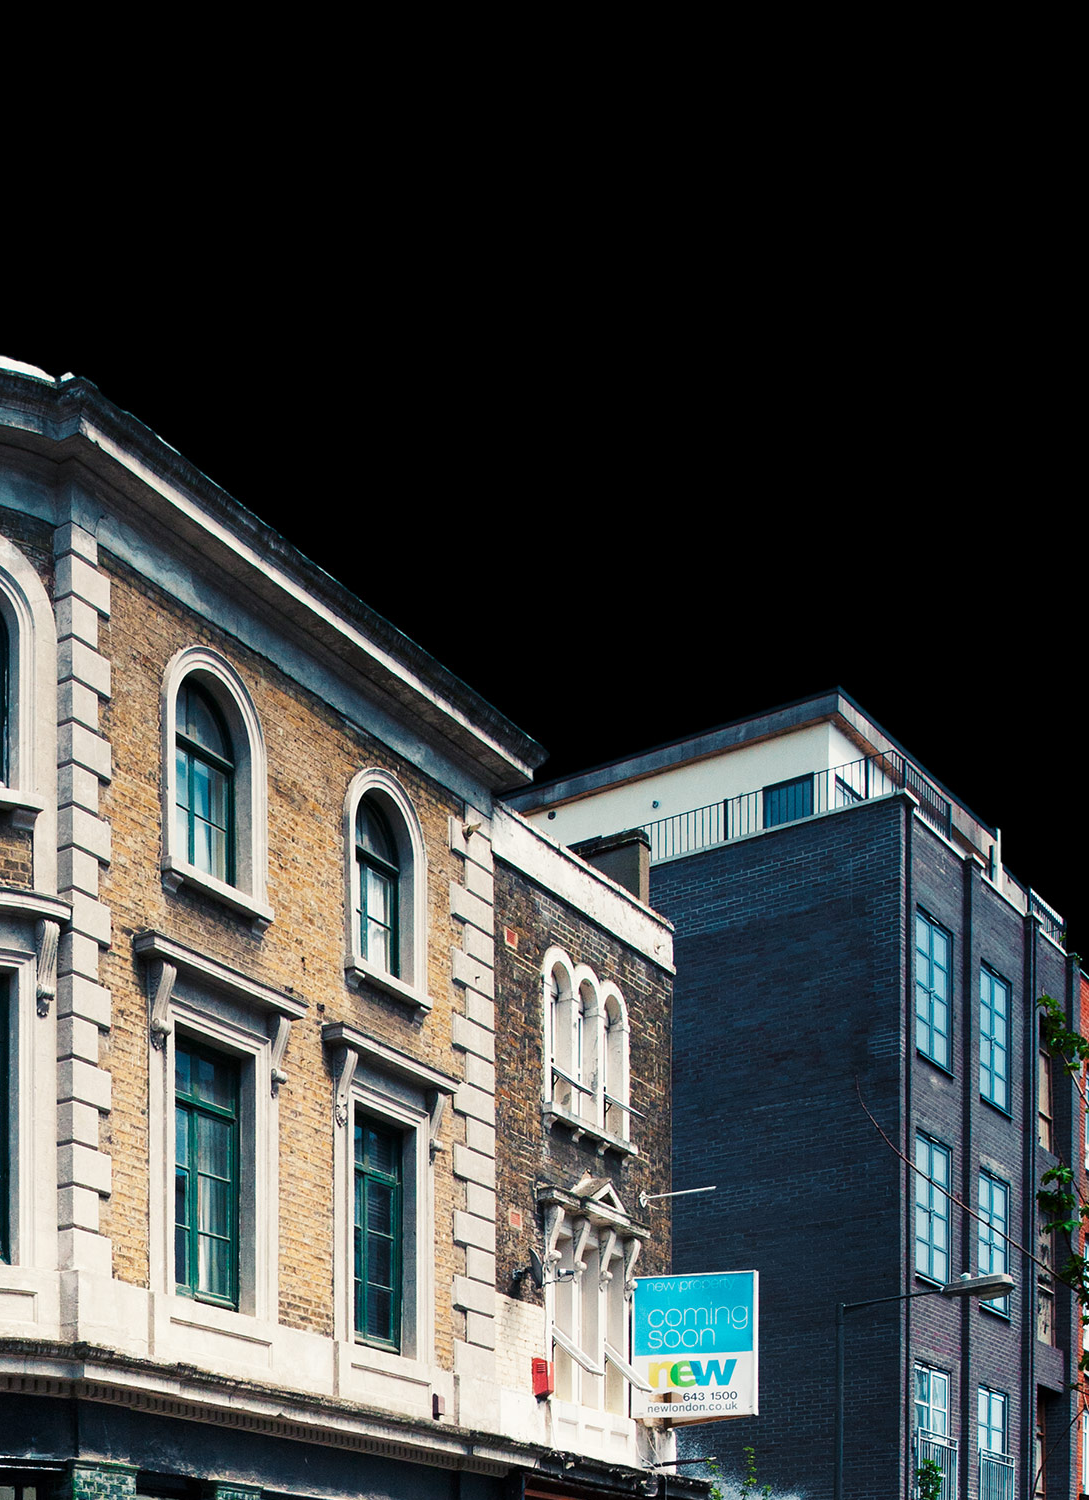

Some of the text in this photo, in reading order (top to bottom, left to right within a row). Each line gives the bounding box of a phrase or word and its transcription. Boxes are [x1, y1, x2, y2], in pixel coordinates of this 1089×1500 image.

[646, 1277, 735, 1293] new property
[647, 1302, 748, 1329] coming
[647, 1327, 716, 1349] soon
[648, 1358, 738, 1388] new
[683, 1391, 738, 1402] 643 1500
[647, 1401, 738, 1413] newlondon.co.uk
